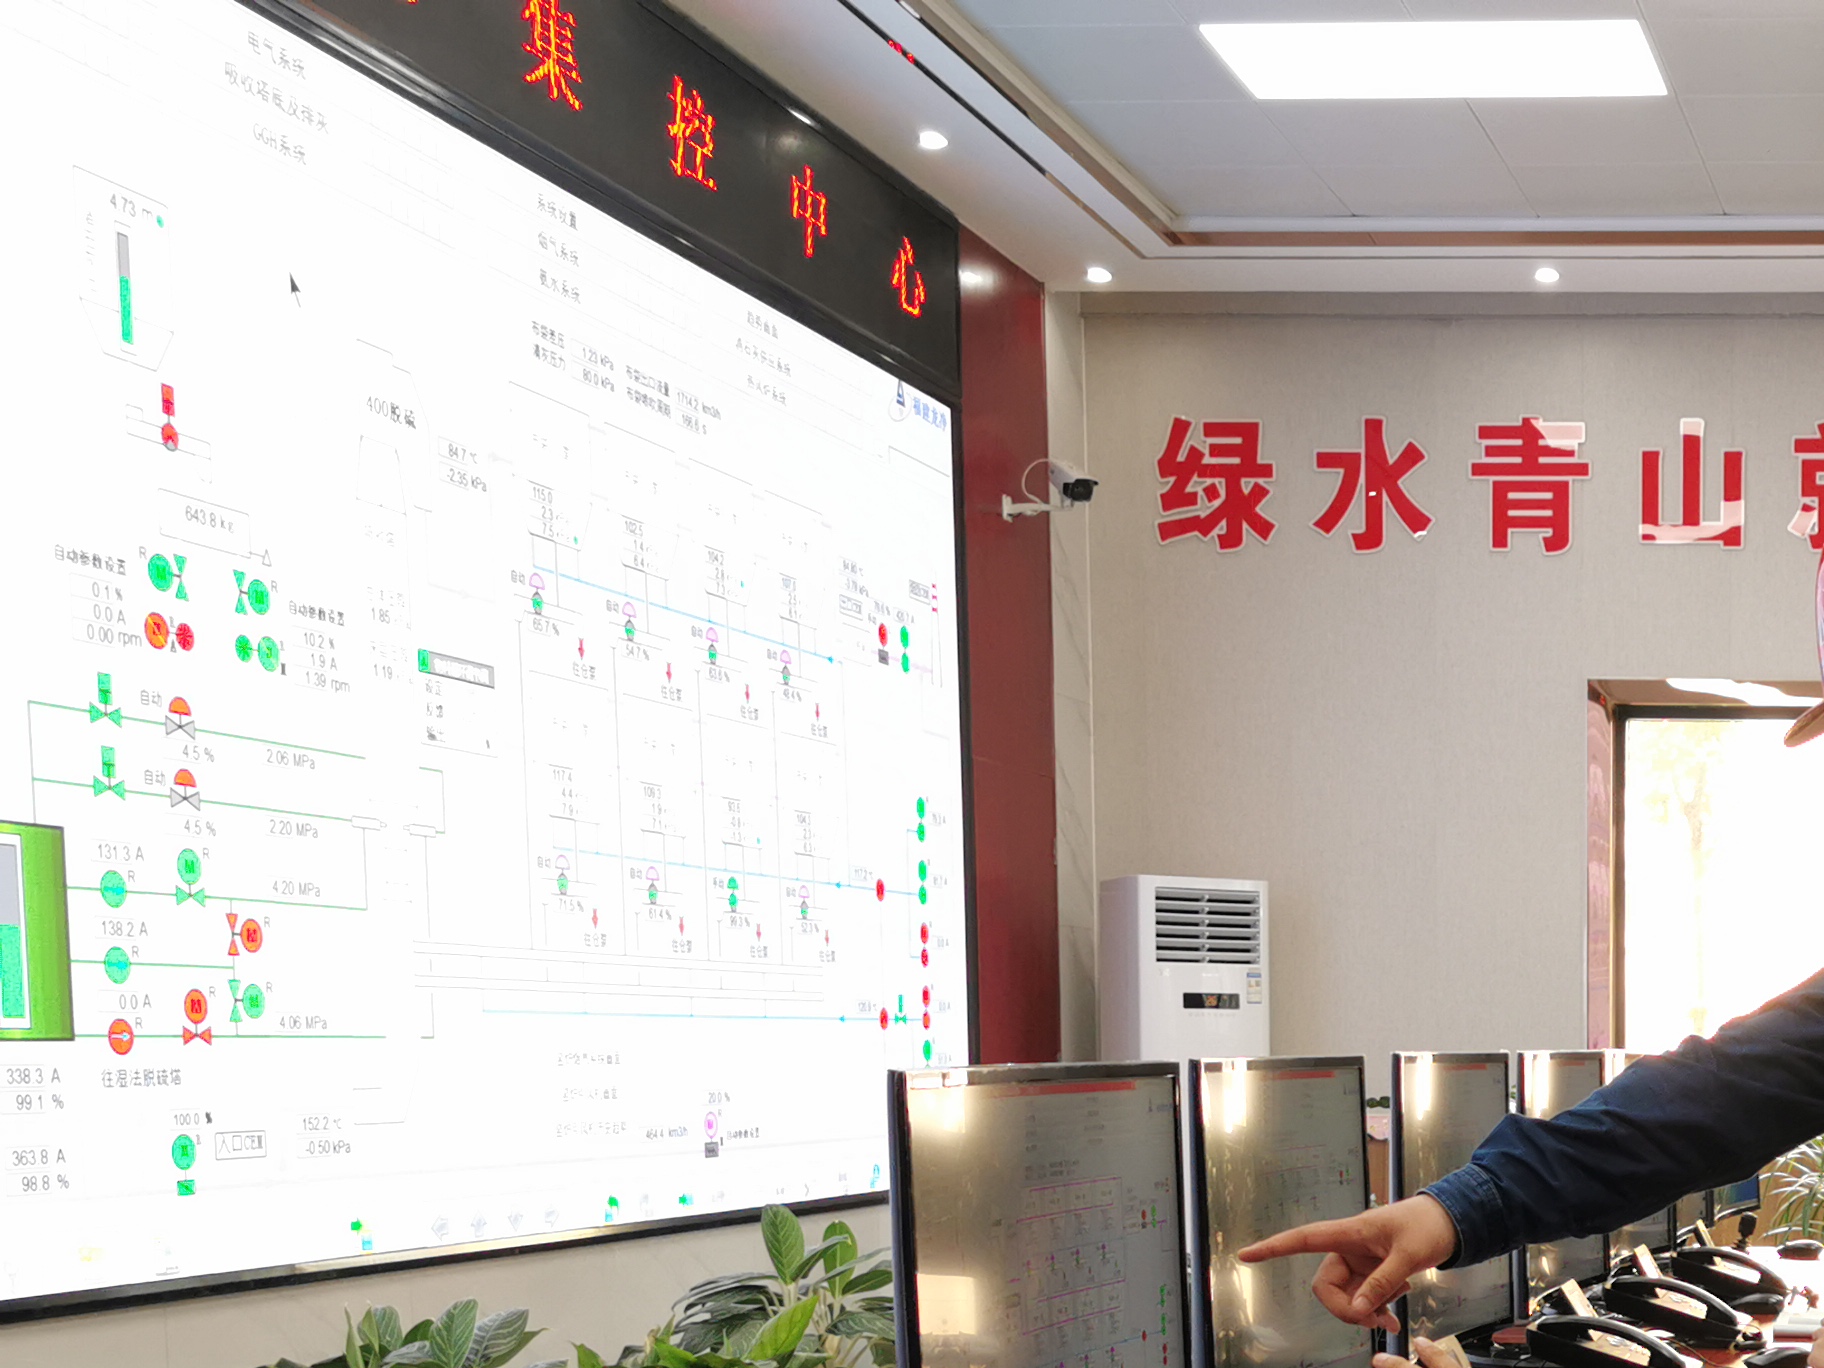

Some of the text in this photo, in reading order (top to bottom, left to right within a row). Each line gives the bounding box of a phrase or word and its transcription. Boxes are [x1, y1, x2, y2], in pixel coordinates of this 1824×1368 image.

[94, 604, 112, 622] 0.0
[87, 624, 142, 647] 0.00 rpm
[331, 679, 350, 692] rpm
[141, 690, 162, 707] 自动
[183, 745, 200, 760] 4.5
[267, 749, 315, 769] 2.06 MPa
[184, 819, 201, 835] 4.5
[270, 819, 318, 838] 2.20 MPa
[98, 844, 130, 861] 131.3
[273, 880, 320, 897] 4.20 MPa
[102, 920, 134, 937] 138.2
[119, 994, 138, 1010] 0.0
[280, 1016, 327, 1029] 4.06 MPa
[7, 1068, 61, 1084] 338.3 A
[101, 1068, 181, 1088] 往湿法脱硫塔
[16, 1094, 64, 1110] 99.1 %
[333, 1140, 351, 1153] kPa
[12, 1149, 66, 1166] 363.8 A
[22, 1174, 69, 1192] 98.8 %
